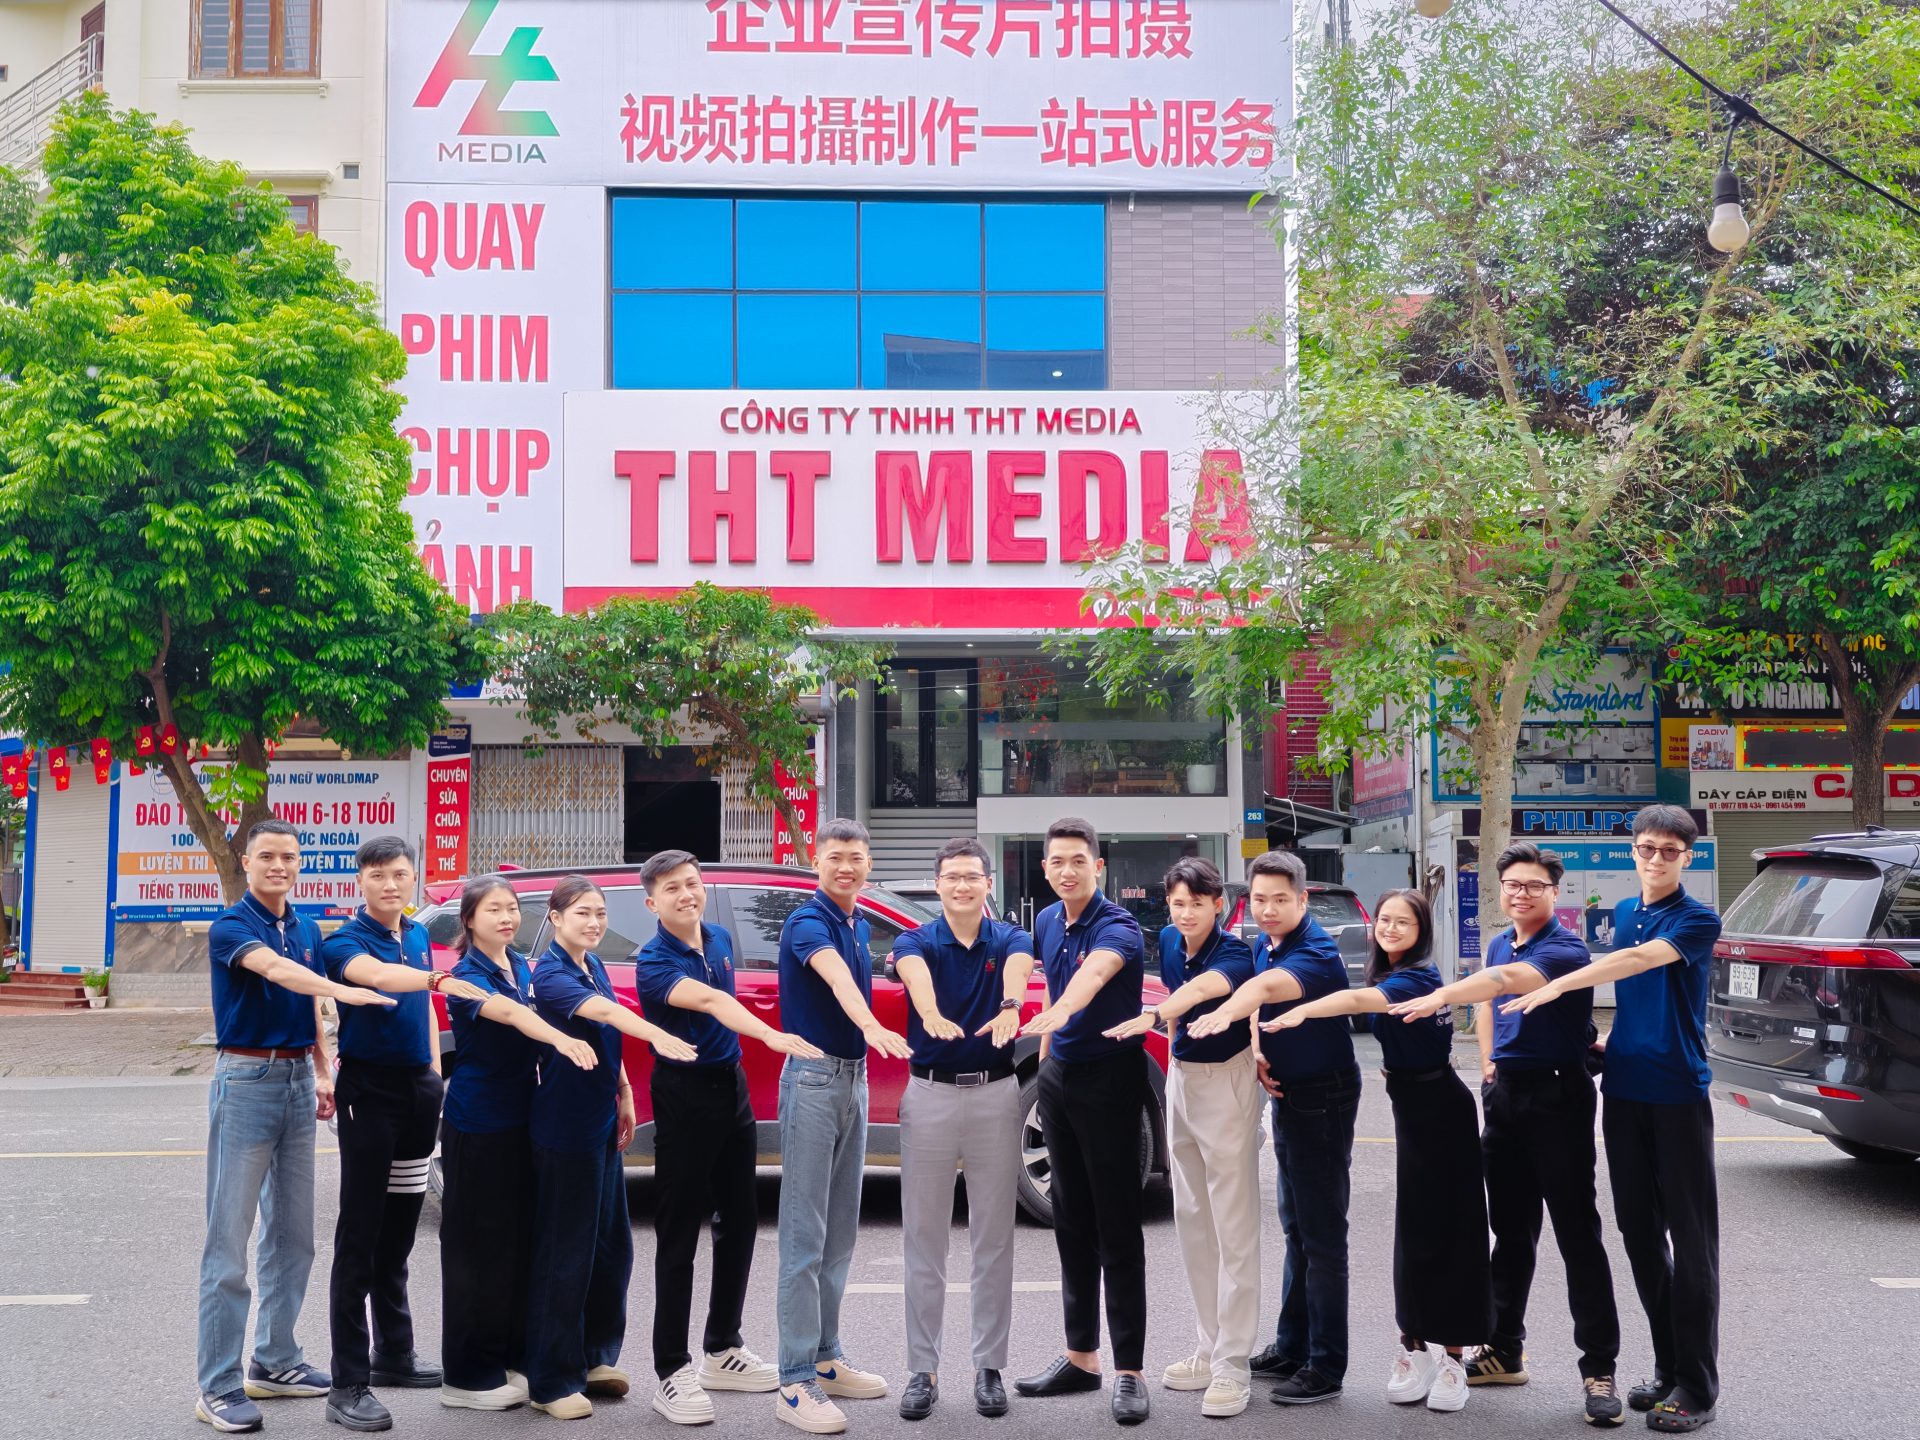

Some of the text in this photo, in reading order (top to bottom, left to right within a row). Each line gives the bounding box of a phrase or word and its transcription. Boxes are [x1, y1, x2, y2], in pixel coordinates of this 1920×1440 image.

[706, 0, 1193, 60] 企业宣传片拍摄
[438, 142, 547, 164] MEDIA
[404, 200, 546, 278] QUAY
[401, 313, 549, 383] PHIM
[720, 398, 1143, 435] CÔNG TY TNHH THT MEDIA
[399, 426, 551, 513] CHỤP
[614, 449, 1258, 564] THT MEDIA
[1546, 681, 1647, 713] Standard
[268, 770, 380, 787] OẠI NGỮ WORLDMAP
[430, 767, 468, 783] CHUYÊN
[439, 787, 458, 805] SỬA
[1698, 787, 1808, 802] DÂY CÁP ĐIỆN
[135, 797, 171, 827] ĐÀO
[272, 802, 307, 825] ANH
[312, 801, 352, 825] 6-18
[357, 791, 395, 825] TUỔI
[434, 810, 461, 828] CHỮA
[1247, 812, 1262, 821] 263
[1523, 811, 1638, 831] PHILIPS
[319, 829, 360, 846] NGOÀI
[435, 835, 460, 849] THAY
[139, 852, 183, 874] LUYỆN
[187, 855, 209, 871] THI
[299, 851, 335, 873] UYỆN
[438, 852, 457, 871] THẾ
[1558, 851, 1579, 859] LIPS
[1608, 851, 1633, 859] PHILI
[138, 877, 356, 901] TIẾNG TRUNG LUYỆN THI
